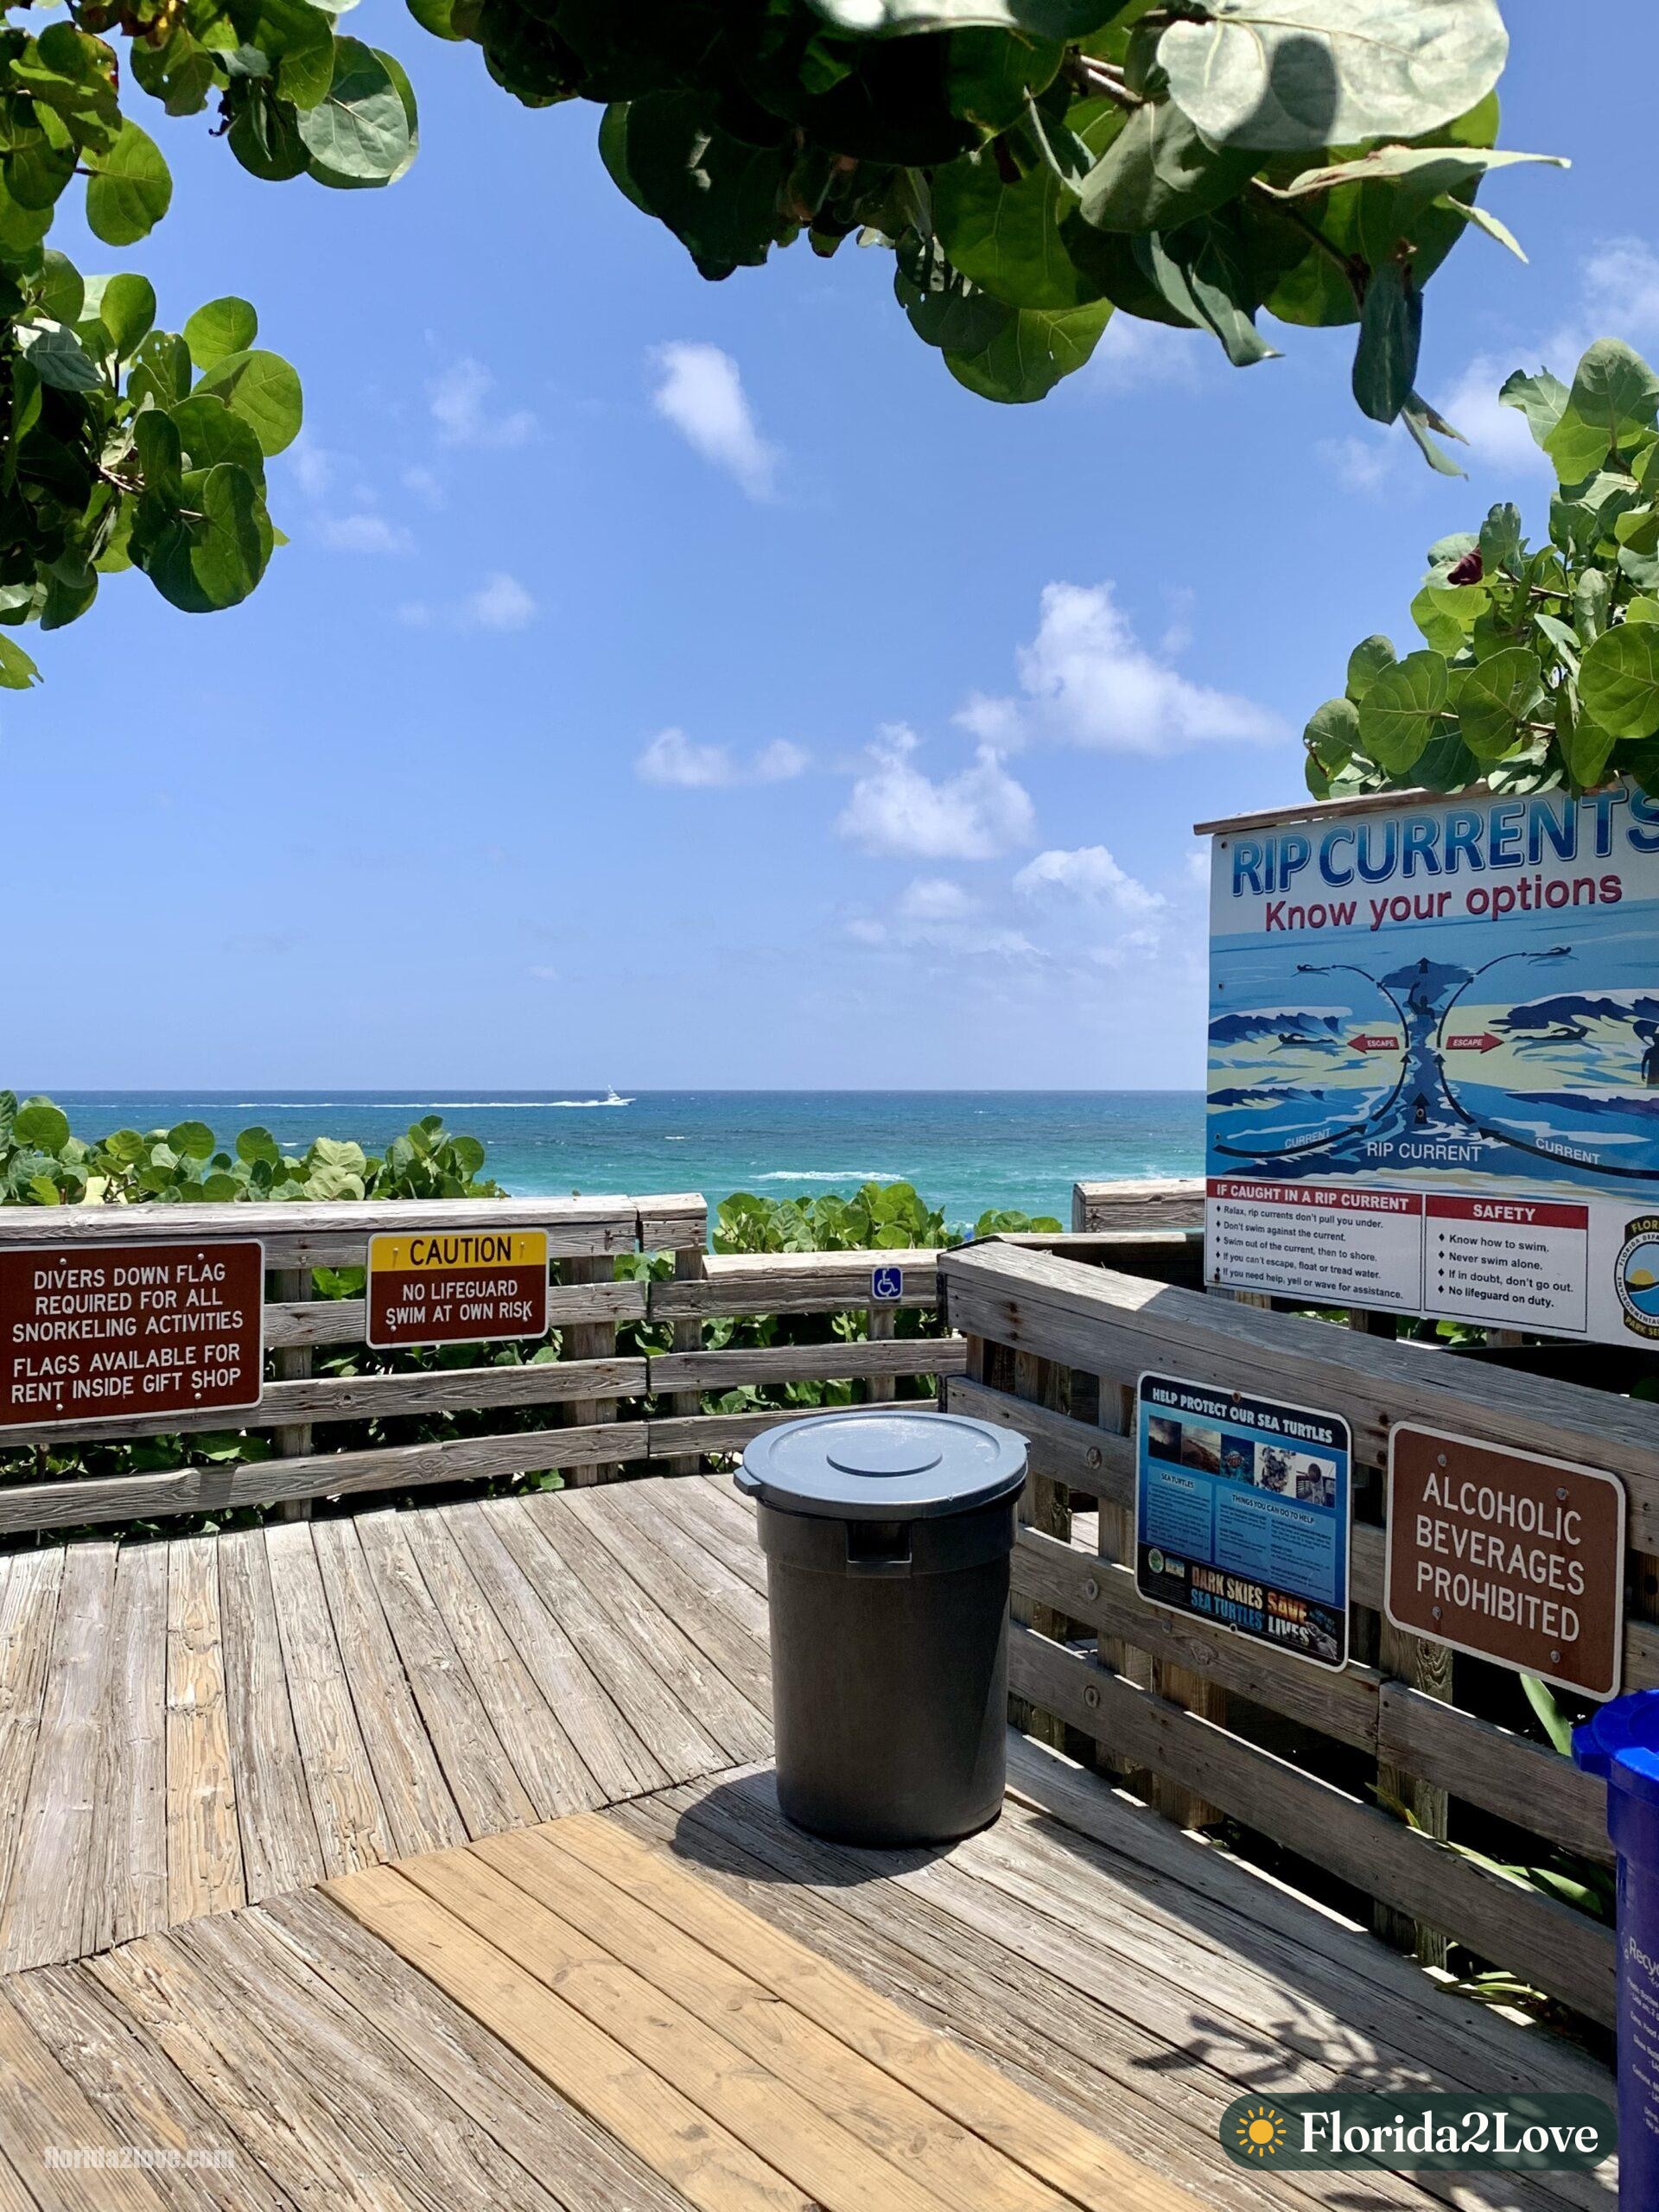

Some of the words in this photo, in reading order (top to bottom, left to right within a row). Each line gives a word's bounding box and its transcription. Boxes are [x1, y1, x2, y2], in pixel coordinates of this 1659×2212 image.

[1232, 834, 1312, 897] RIP
[1265, 900, 1357, 931] Know
[1370, 890, 1452, 931] your
[1465, 873, 1623, 921] options
[1367, 1039, 1395, 1048] ESCAPE
[1453, 1037, 1483, 1046] ESCAPE
[1284, 1128, 1331, 1148] CURRENT
[1535, 1137, 1601, 1164] CURRENT
[1367, 1142, 1392, 1158] RIP
[1398, 1143, 1482, 1162] CURRENT
[1217, 1185, 1227, 1196] IF
[1230, 1185, 1281, 1200] CAUGHT
[1285, 1189, 1298, 1201] IN
[1302, 1192, 1311, 1203] A
[1315, 1192, 1337, 1205] RIP
[1341, 1194, 1408, 1211] CURRENT
[1224, 1205, 1246, 1217] Relax,
[1249, 1208, 1259, 1218] rip
[1261, 1210, 1293, 1220] currents
[1296, 1211, 1317, 1222] don't
[1319, 1214, 1335, 1225] pull
[1337, 1217, 1353, 1227] you
[1356, 1218, 1383, 1229] under.
[1473, 1204, 1536, 1222] SAFETY
[1631, 1219, 1659, 1233] FLOR
[1224, 1221, 1243, 1231] Don't
[1245, 1224, 1265, 1233] swim
[1267, 1226, 1296, 1237] against
[1298, 1228, 1312, 1237] the
[1313, 1231, 1346, 1242] current.
[1450, 1234, 1478, 1245] Know
[1481, 1237, 1502, 1248] how
[1505, 1239, 1516, 1249] to
[1519, 1241, 1549, 1252] swim.
[410, 1236, 512, 1266] CAUTION
[1224, 1236, 1243, 1247] Swim
[1245, 1239, 1258, 1249] out
[1260, 1240, 1268, 1249] of
[1270, 1241, 1282, 1250] the
[1284, 1243, 1315, 1255] current,
[1318, 1247, 1337, 1257] then
[1339, 1249, 1348, 1258] to
[1350, 1251, 1377, 1262] shore.
[1449, 1252, 1478, 1263] Never
[1481, 1255, 1508, 1267] swim
[1511, 1259, 1543, 1270] alone.
[1619, 1238, 1640, 1267] FLORIDA
[34, 1268, 105, 1290] DIVERS
[113, 1266, 169, 1287] DOWN
[176, 1263, 226, 1283] FLAG
[1224, 1252, 1229, 1261] If
[1230, 1255, 1244, 1264] you
[1246, 1255, 1264, 1265] can't
[1267, 1259, 1296, 1270] escape,
[1299, 1260, 1318, 1270] float
[1319, 1263, 1329, 1272] or
[1331, 1264, 1352, 1275] tread
[1355, 1268, 1381, 1279] water.
[403, 1283, 425, 1301] NO
[430, 1280, 518, 1300] LIFEGUARD
[1224, 1268, 1229, 1276] If
[1230, 1270, 1244, 1280] you
[1245, 1270, 1265, 1281] need
[1267, 1274, 1286, 1286] help,
[1287, 1276, 1301, 1287] yell
[1303, 1279, 1313, 1287] or
[1315, 1281, 1337, 1291] wave
[1338, 1282, 1351, 1293] for
[1353, 1284, 1403, 1300] assistance.
[1448, 1269, 1455, 1279] If
[1459, 1270, 1467, 1280] in
[1471, 1272, 1503, 1286] doubt,
[1506, 1275, 1533, 1287] don't
[1536, 1281, 1550, 1291] go
[1553, 1282, 1573, 1293] out.
[35, 1293, 132, 1315] REQUIRED
[140, 1290, 178, 1310] FOR
[186, 1287, 223, 1307] ALL
[1448, 1286, 1463, 1296] No
[1465, 1287, 1510, 1301] lifeguard
[1512, 1294, 1525, 1303] on
[1528, 1296, 1554, 1308] duty.
[385, 1306, 425, 1325] SWIM
[432, 1305, 453, 1322] AT
[460, 1302, 494, 1321] OWN
[499, 1300, 533, 1319] RISK
[1625, 1316, 1647, 1334] PARK
[12, 1317, 137, 1343] SNORKELING
[145, 1310, 244, 1335] ACTIVITIES
[13, 1354, 80, 1378] FLAGS
[89, 1346, 197, 1372] AVAILABLE
[204, 1343, 240, 1363] FOR
[11, 1381, 65, 1404] RENT
[73, 1376, 135, 1399] INSIDE
[143, 1372, 183, 1393] GIFT
[191, 1367, 242, 1389] SHOP
[1153, 1388, 1178, 1405] HELP
[1180, 1395, 1227, 1417] PROTECT
[1230, 1406, 1255, 1425] OUR
[1258, 1414, 1281, 1431] SEA
[1283, 1419, 1333, 1444] TURTLES
[1161, 1472, 1172, 1481] SEA
[1172, 1475, 1194, 1488] TURTLES
[1232, 1495, 1254, 1507] THINGS
[1255, 1502, 1267, 1510] YOU
[1267, 1504, 1279, 1515] CAN
[1281, 1509, 1289, 1517] DO
[1300, 1514, 1315, 1524] HELP
[1422, 1472, 1582, 1547] ALCOHOLIC
[1415, 1514, 1585, 1597] BEVERAGES
[1192, 1566, 1225, 1596] DARK
[1227, 1576, 1262, 1610] SKIES
[1267, 1591, 1307, 1624] SAVE
[1417, 1560, 1580, 1642] PROHIBITED
[1191, 1588, 1211, 1612] SEA
[1268, 1614, 1310, 1646] LIVES
